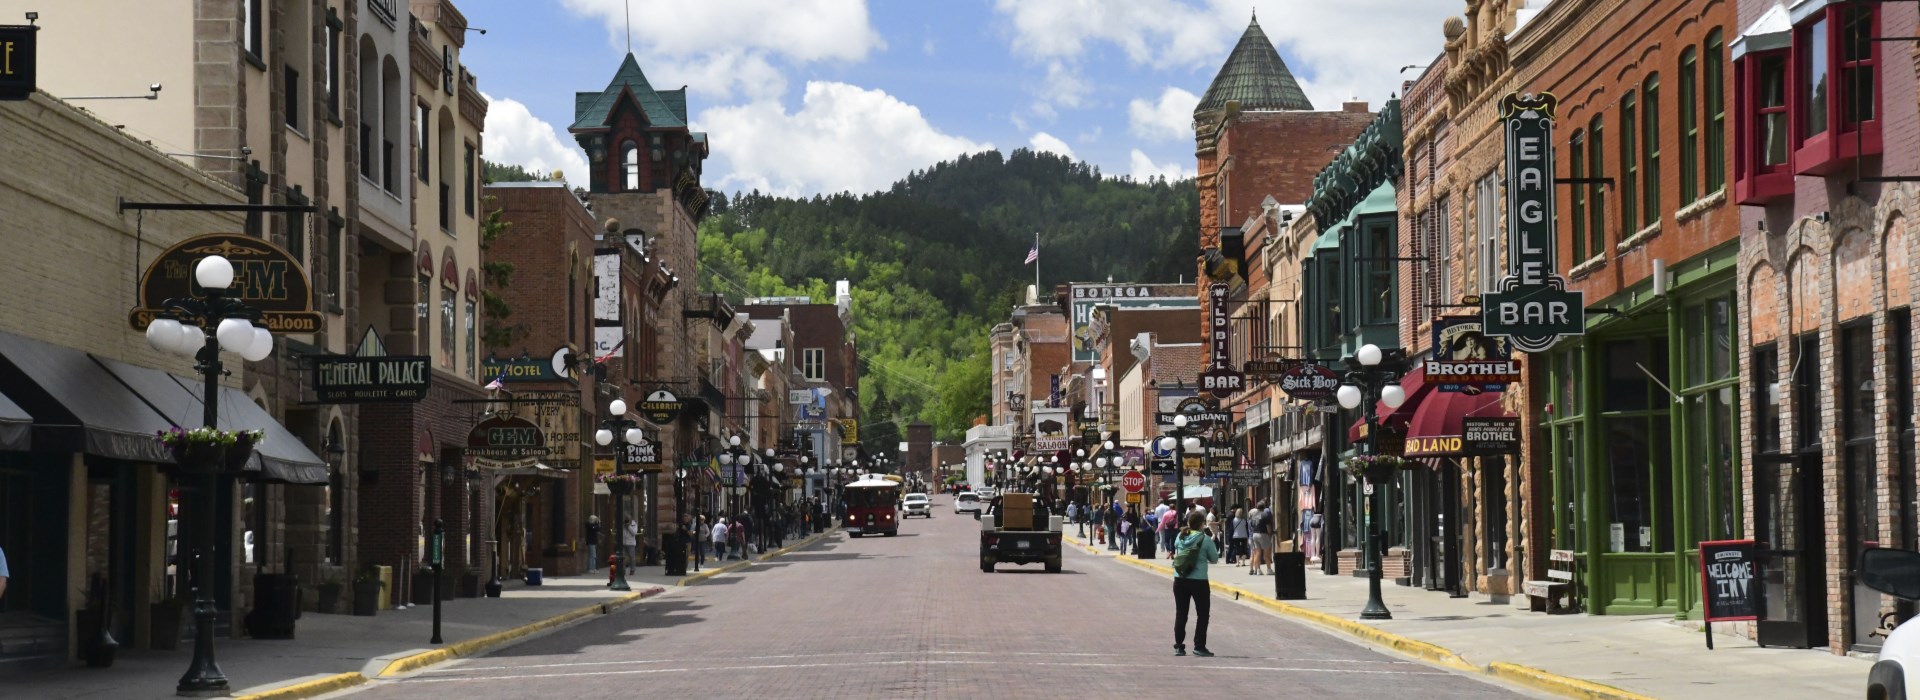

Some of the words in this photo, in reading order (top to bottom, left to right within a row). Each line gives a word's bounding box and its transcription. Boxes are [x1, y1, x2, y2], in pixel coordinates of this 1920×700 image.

[0, 41, 14, 74] E
[1520, 137, 1543, 285] EAGLE
[1075, 287, 1150, 298] BODEGA
[1500, 301, 1570, 325] BAR
[1446, 325, 1475, 335] HISTORIC
[1216, 331, 1226, 369] BILL
[379, 361, 425, 384] PALACE
[505, 364, 541, 376] HOTEL
[1426, 361, 1520, 375] BROTHEL
[1204, 375, 1240, 389] BAR
[1282, 375, 1311, 390] Sick
[1312, 375, 1337, 390] Boy
[641, 402, 683, 410] CELEBRITY
[1161, 413, 1227, 422] REAURANT
[488, 427, 536, 445] GEM
[551, 433, 579, 441] HORSE
[1467, 432, 1516, 441] BROTHEL
[627, 445, 655, 456] PINK
[1037, 441, 1067, 450] SALOON
[1208, 447, 1234, 457] TRIAL
[1405, 438, 1420, 453] BAD
[1422, 437, 1462, 452] LAND
[1124, 477, 1144, 486] STOP
[1707, 561, 1753, 579] WELCOME
[1716, 578, 1748, 599] IN!
